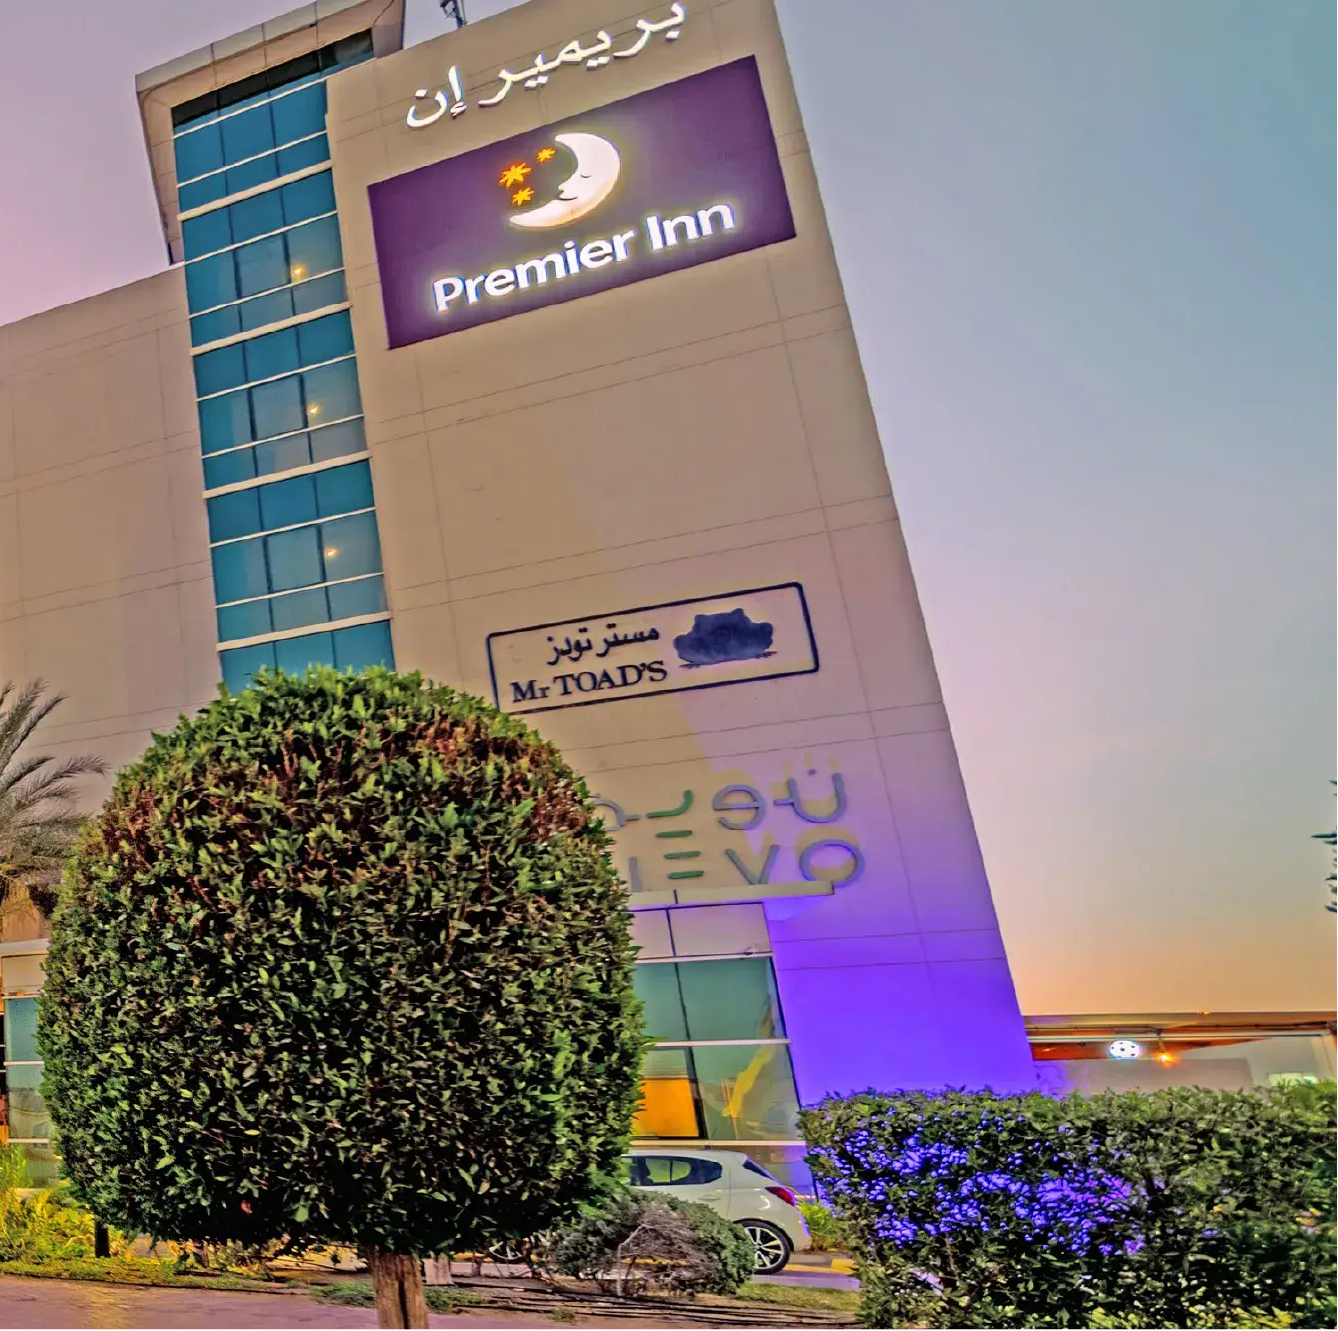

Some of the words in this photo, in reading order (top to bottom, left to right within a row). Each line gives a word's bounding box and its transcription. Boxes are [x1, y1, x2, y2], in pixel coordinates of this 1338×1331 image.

[478, 1, 685, 106] بريمير
[405, 65, 467, 128] إن
[432, 228, 636, 313] Premier
[646, 203, 735, 253] Inn
[595, 623, 660, 657] مستر
[510, 680, 550, 703] Mr
[553, 660, 668, 696] TOAD'S
[627, 830, 865, 892] EVO
